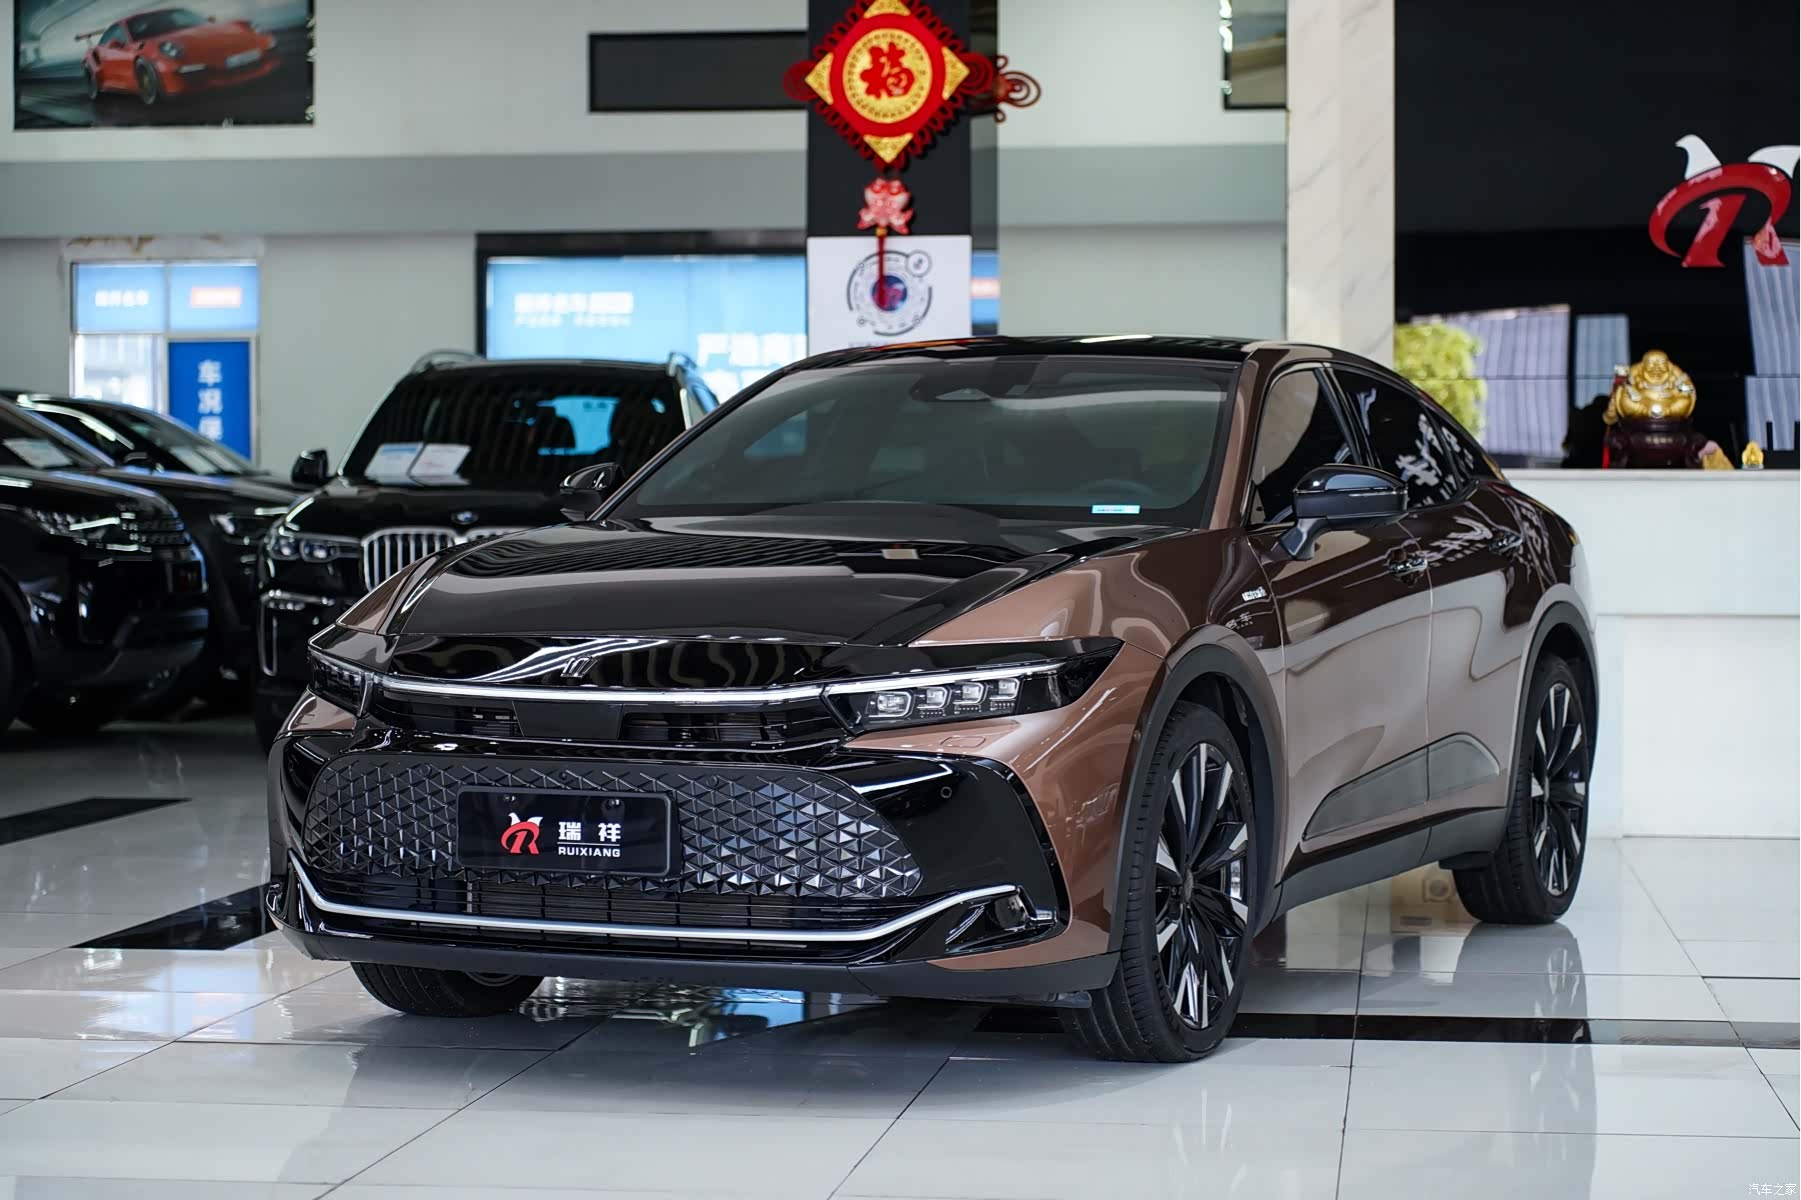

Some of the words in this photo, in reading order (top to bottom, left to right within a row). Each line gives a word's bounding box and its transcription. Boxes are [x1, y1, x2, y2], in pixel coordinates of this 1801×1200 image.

[860, 41, 915, 99] 福
[558, 821, 622, 843] 瑞祥
[558, 846, 621, 857] RUIXIANG
